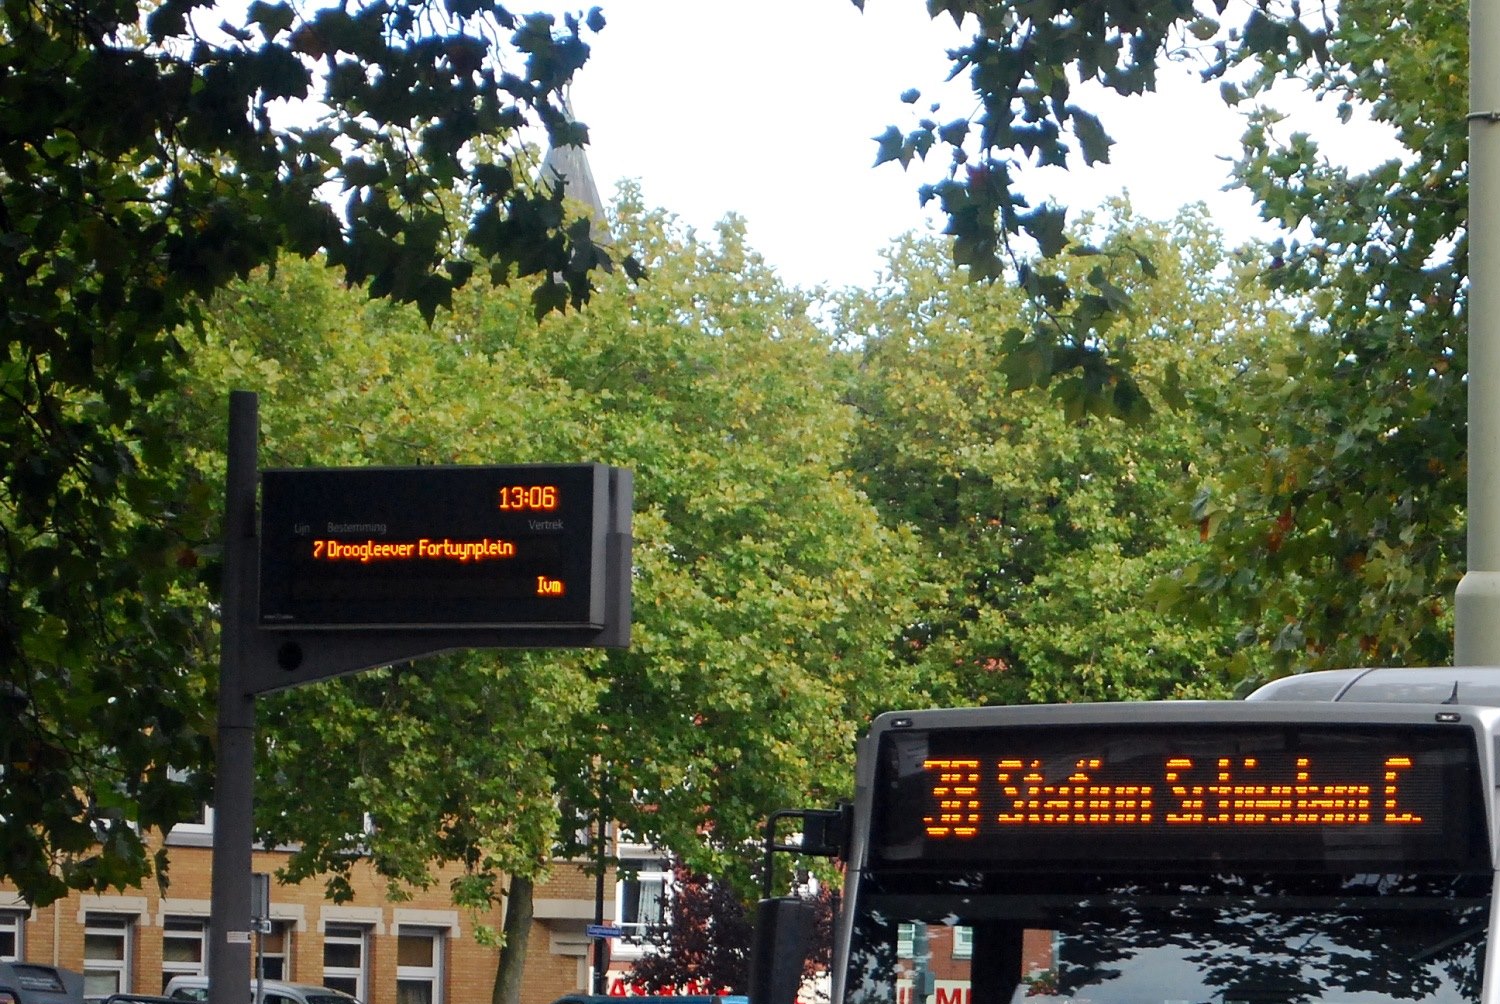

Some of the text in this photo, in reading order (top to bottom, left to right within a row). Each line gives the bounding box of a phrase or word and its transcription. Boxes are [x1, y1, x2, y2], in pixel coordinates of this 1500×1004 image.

[499, 486, 556, 510] 13:06
[327, 521, 387, 534] Bestemming
[529, 519, 564, 530] Vertrek
[313, 540, 513, 562] 7 Droogleever Fortuynplein
[1385, 757, 1422, 821] C
